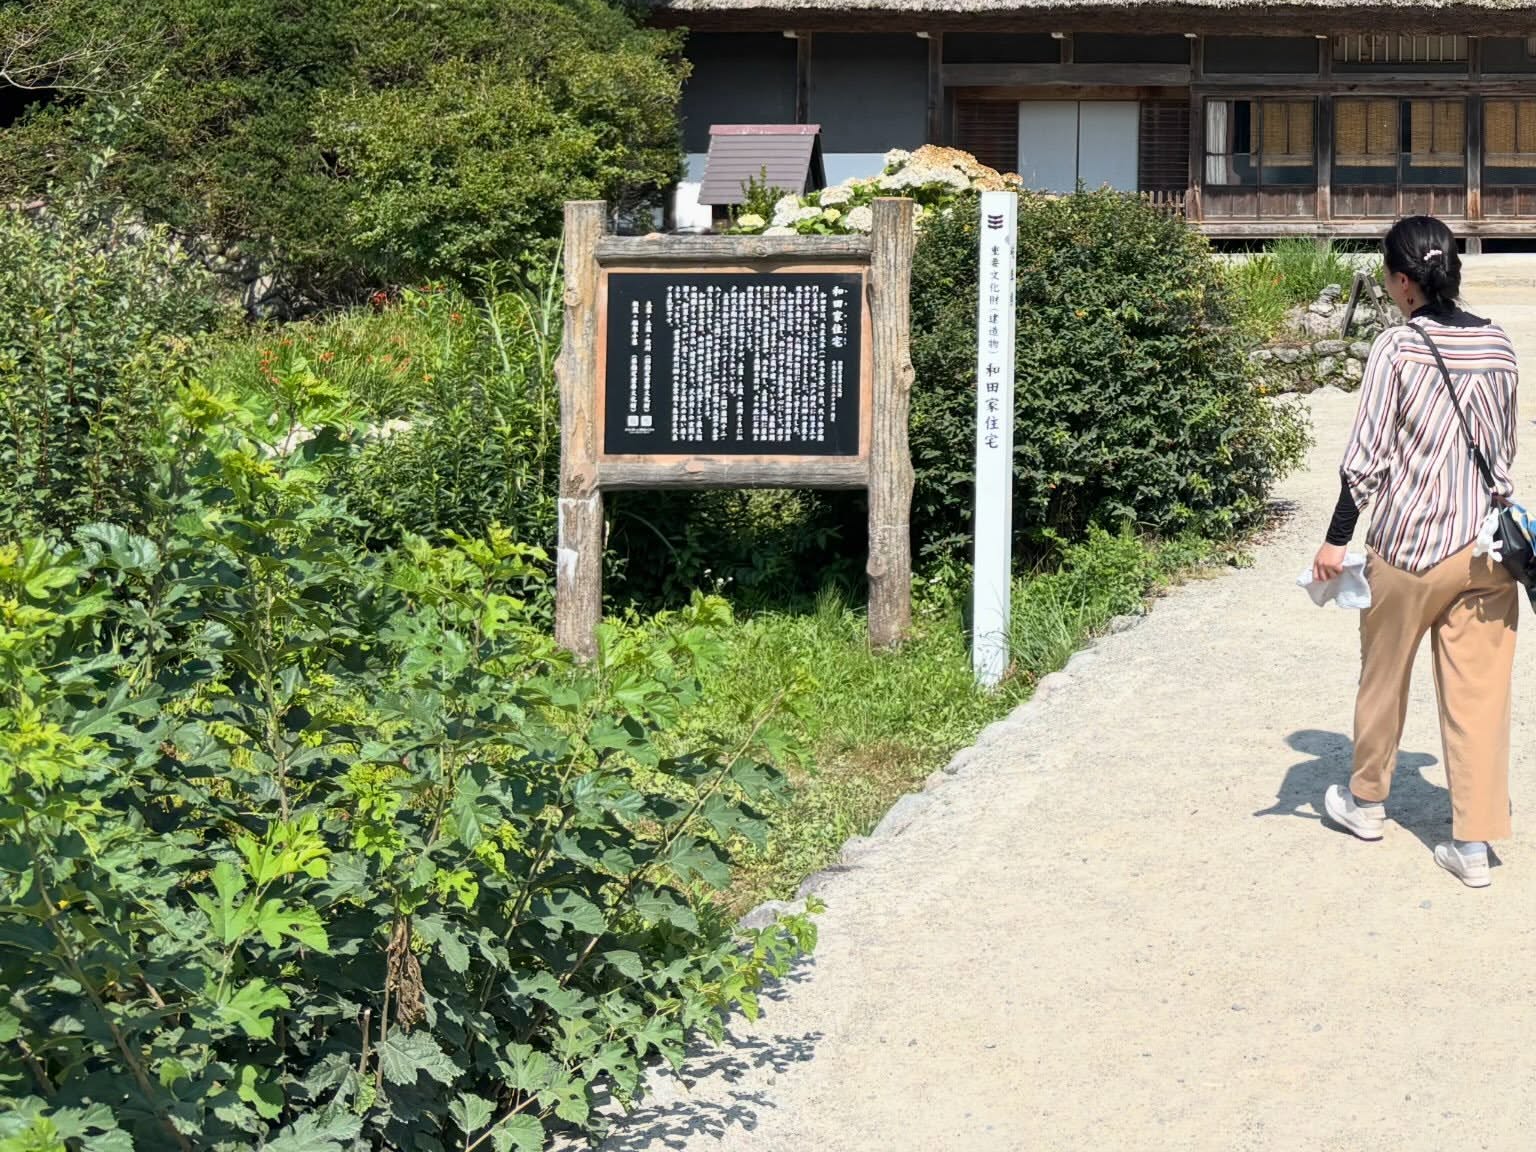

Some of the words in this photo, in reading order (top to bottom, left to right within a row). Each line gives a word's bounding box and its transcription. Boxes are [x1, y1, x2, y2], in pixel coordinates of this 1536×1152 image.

[831, 285, 844, 348] 和田家住宅
[985, 363, 1000, 449] 和田家住宅
